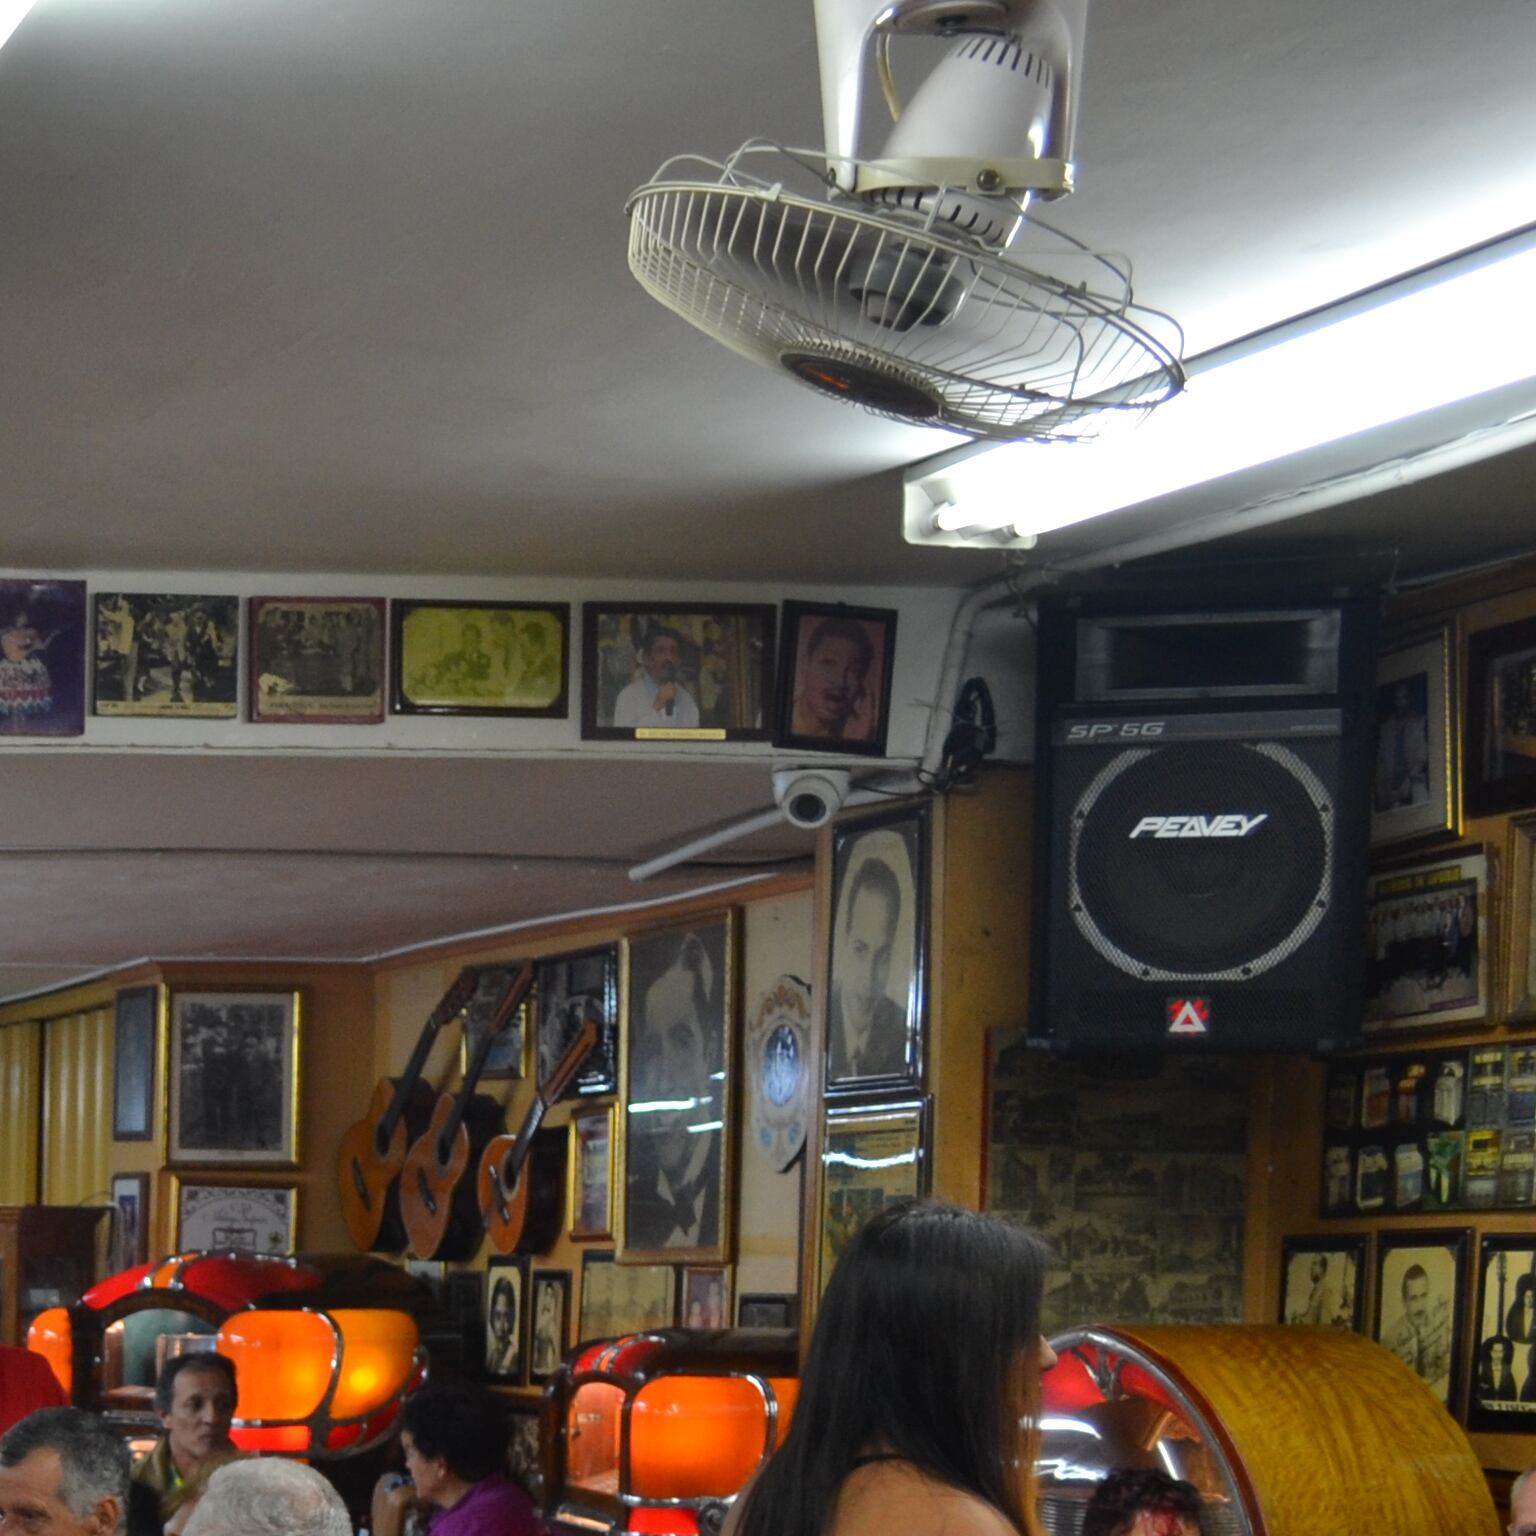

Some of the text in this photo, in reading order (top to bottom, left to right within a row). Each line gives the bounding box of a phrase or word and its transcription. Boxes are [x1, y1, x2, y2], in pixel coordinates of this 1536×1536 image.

[1068, 722, 1166, 739] SP 5G
[1129, 814, 1268, 839] PEAVEY
